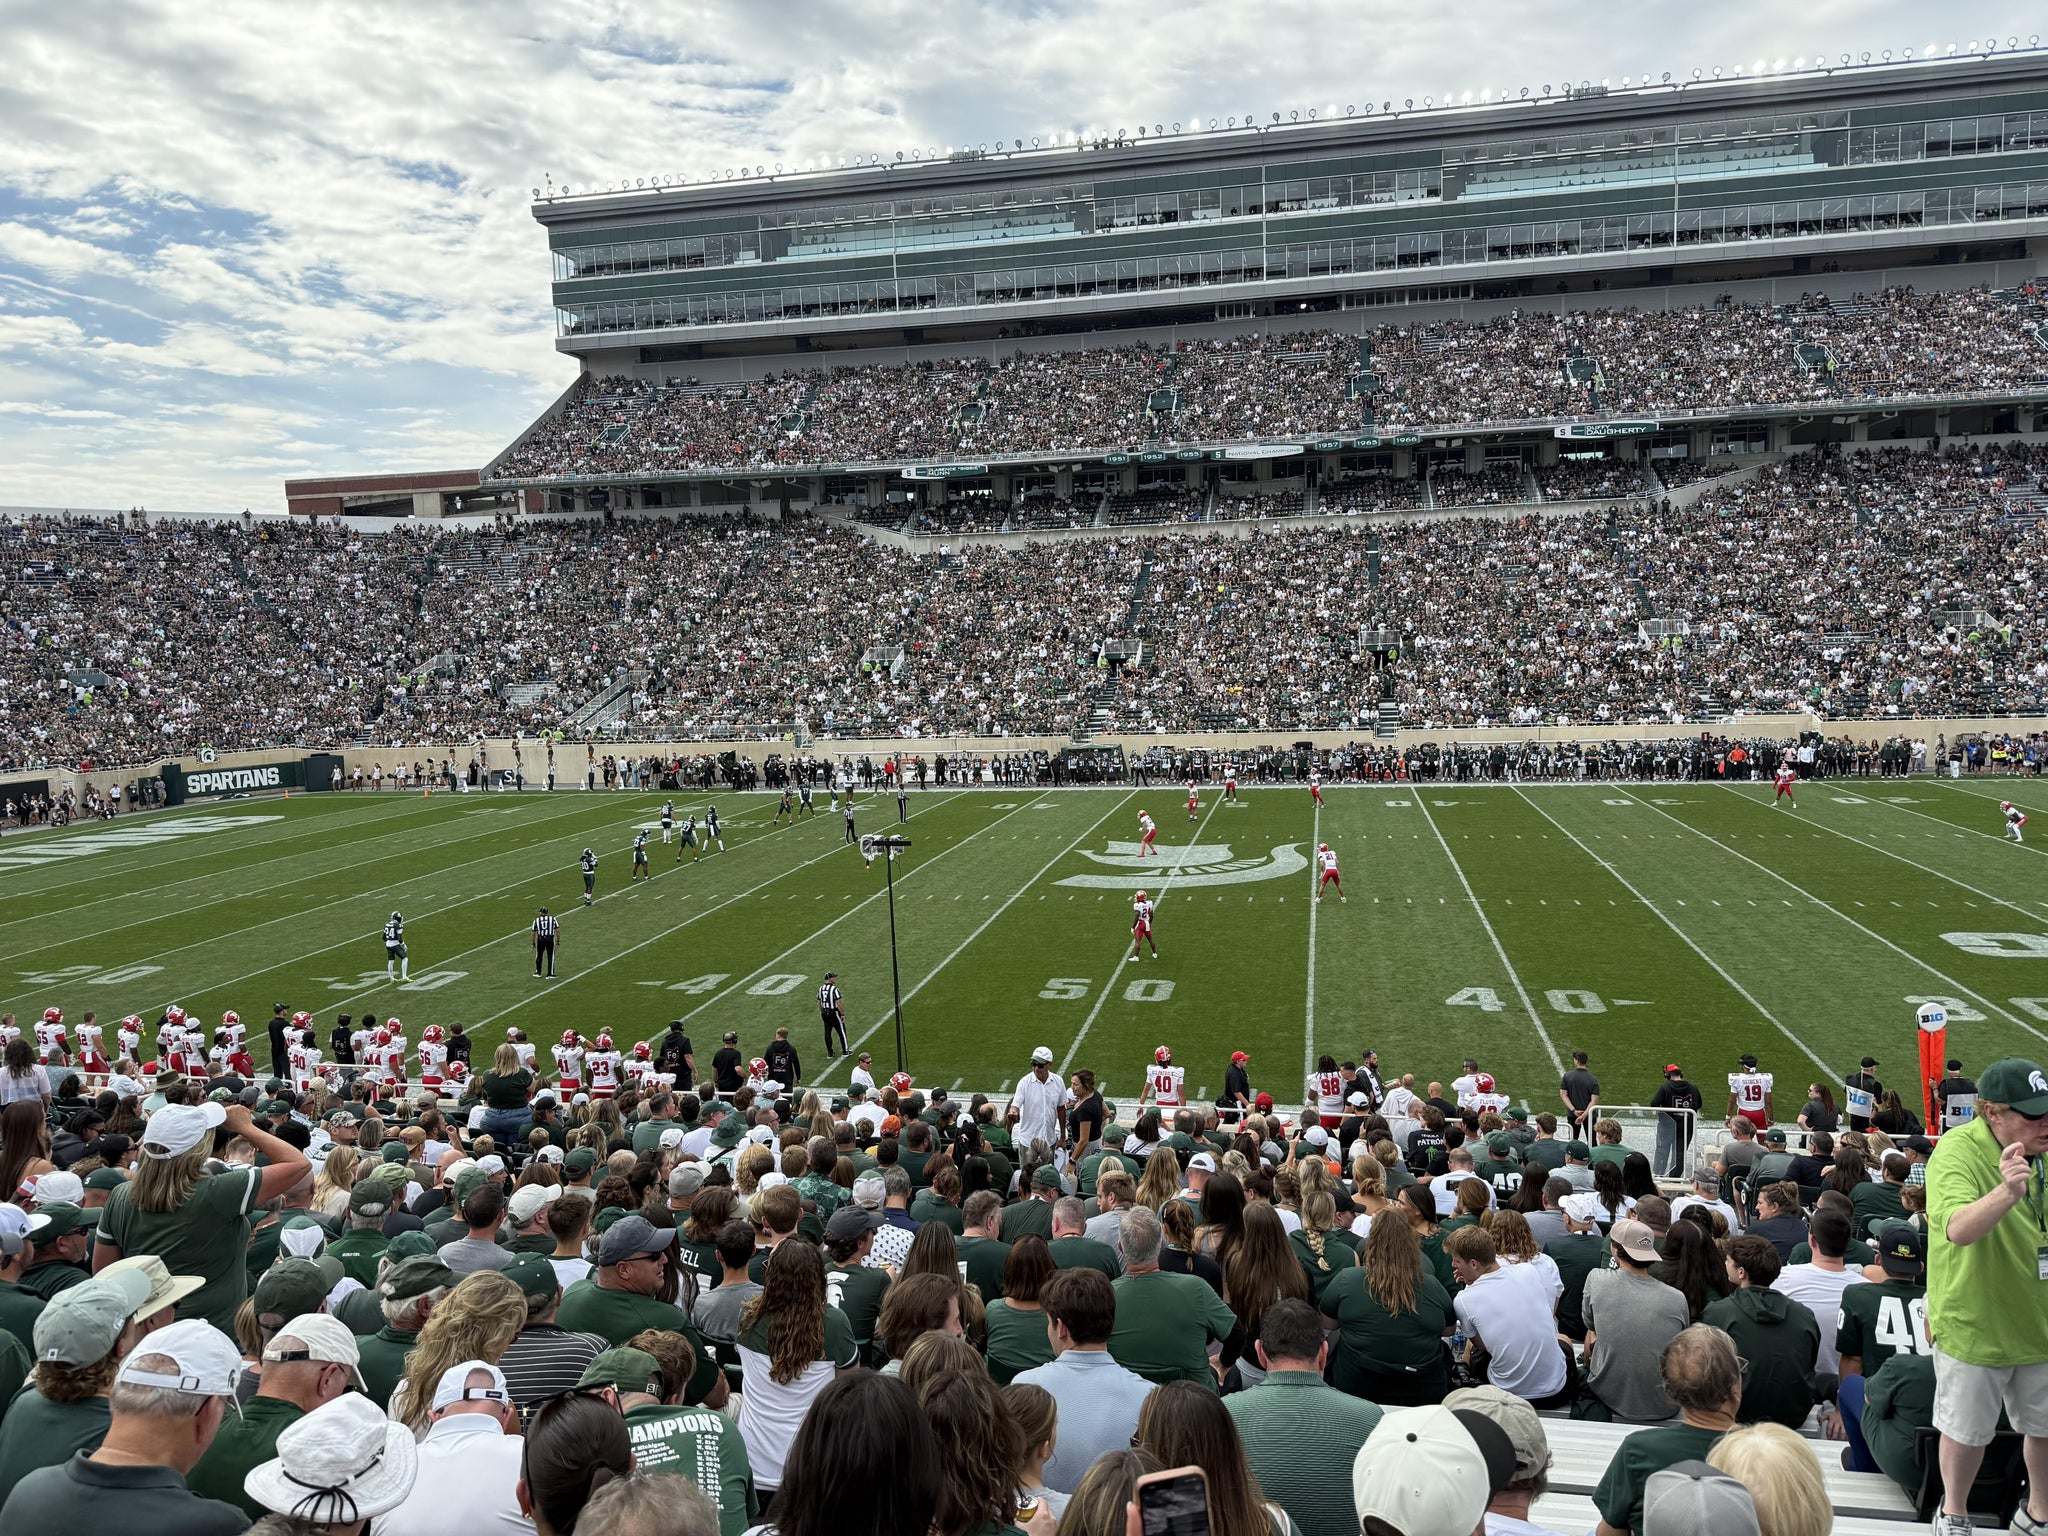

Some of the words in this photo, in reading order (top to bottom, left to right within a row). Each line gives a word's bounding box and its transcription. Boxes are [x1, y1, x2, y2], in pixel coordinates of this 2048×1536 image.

[1586, 426, 1647, 436] DAUGHERTY
[187, 767, 280, 794] SPARTANS
[385, 927, 395, 938] 24
[666, 974, 809, 995] 40
[1038, 977, 1177, 1001] 50
[1445, 986, 1608, 1014] 40
[37, 1030, 49, 1045] 55
[293, 1053, 307, 1071] 90
[419, 1048, 431, 1066] 56
[775, 1055, 787, 1065] Fe
[557, 1058, 570, 1074] 41
[592, 1060, 610, 1077] 23
[1154, 1075, 1172, 1093] 40
[1320, 1078, 1341, 1096] 98
[1743, 1084, 1763, 1101] 19
[1675, 1098, 1690, 1108] Fe
[647, 1384, 654, 1392] S
[637, 1442, 665, 1451] Michigan
